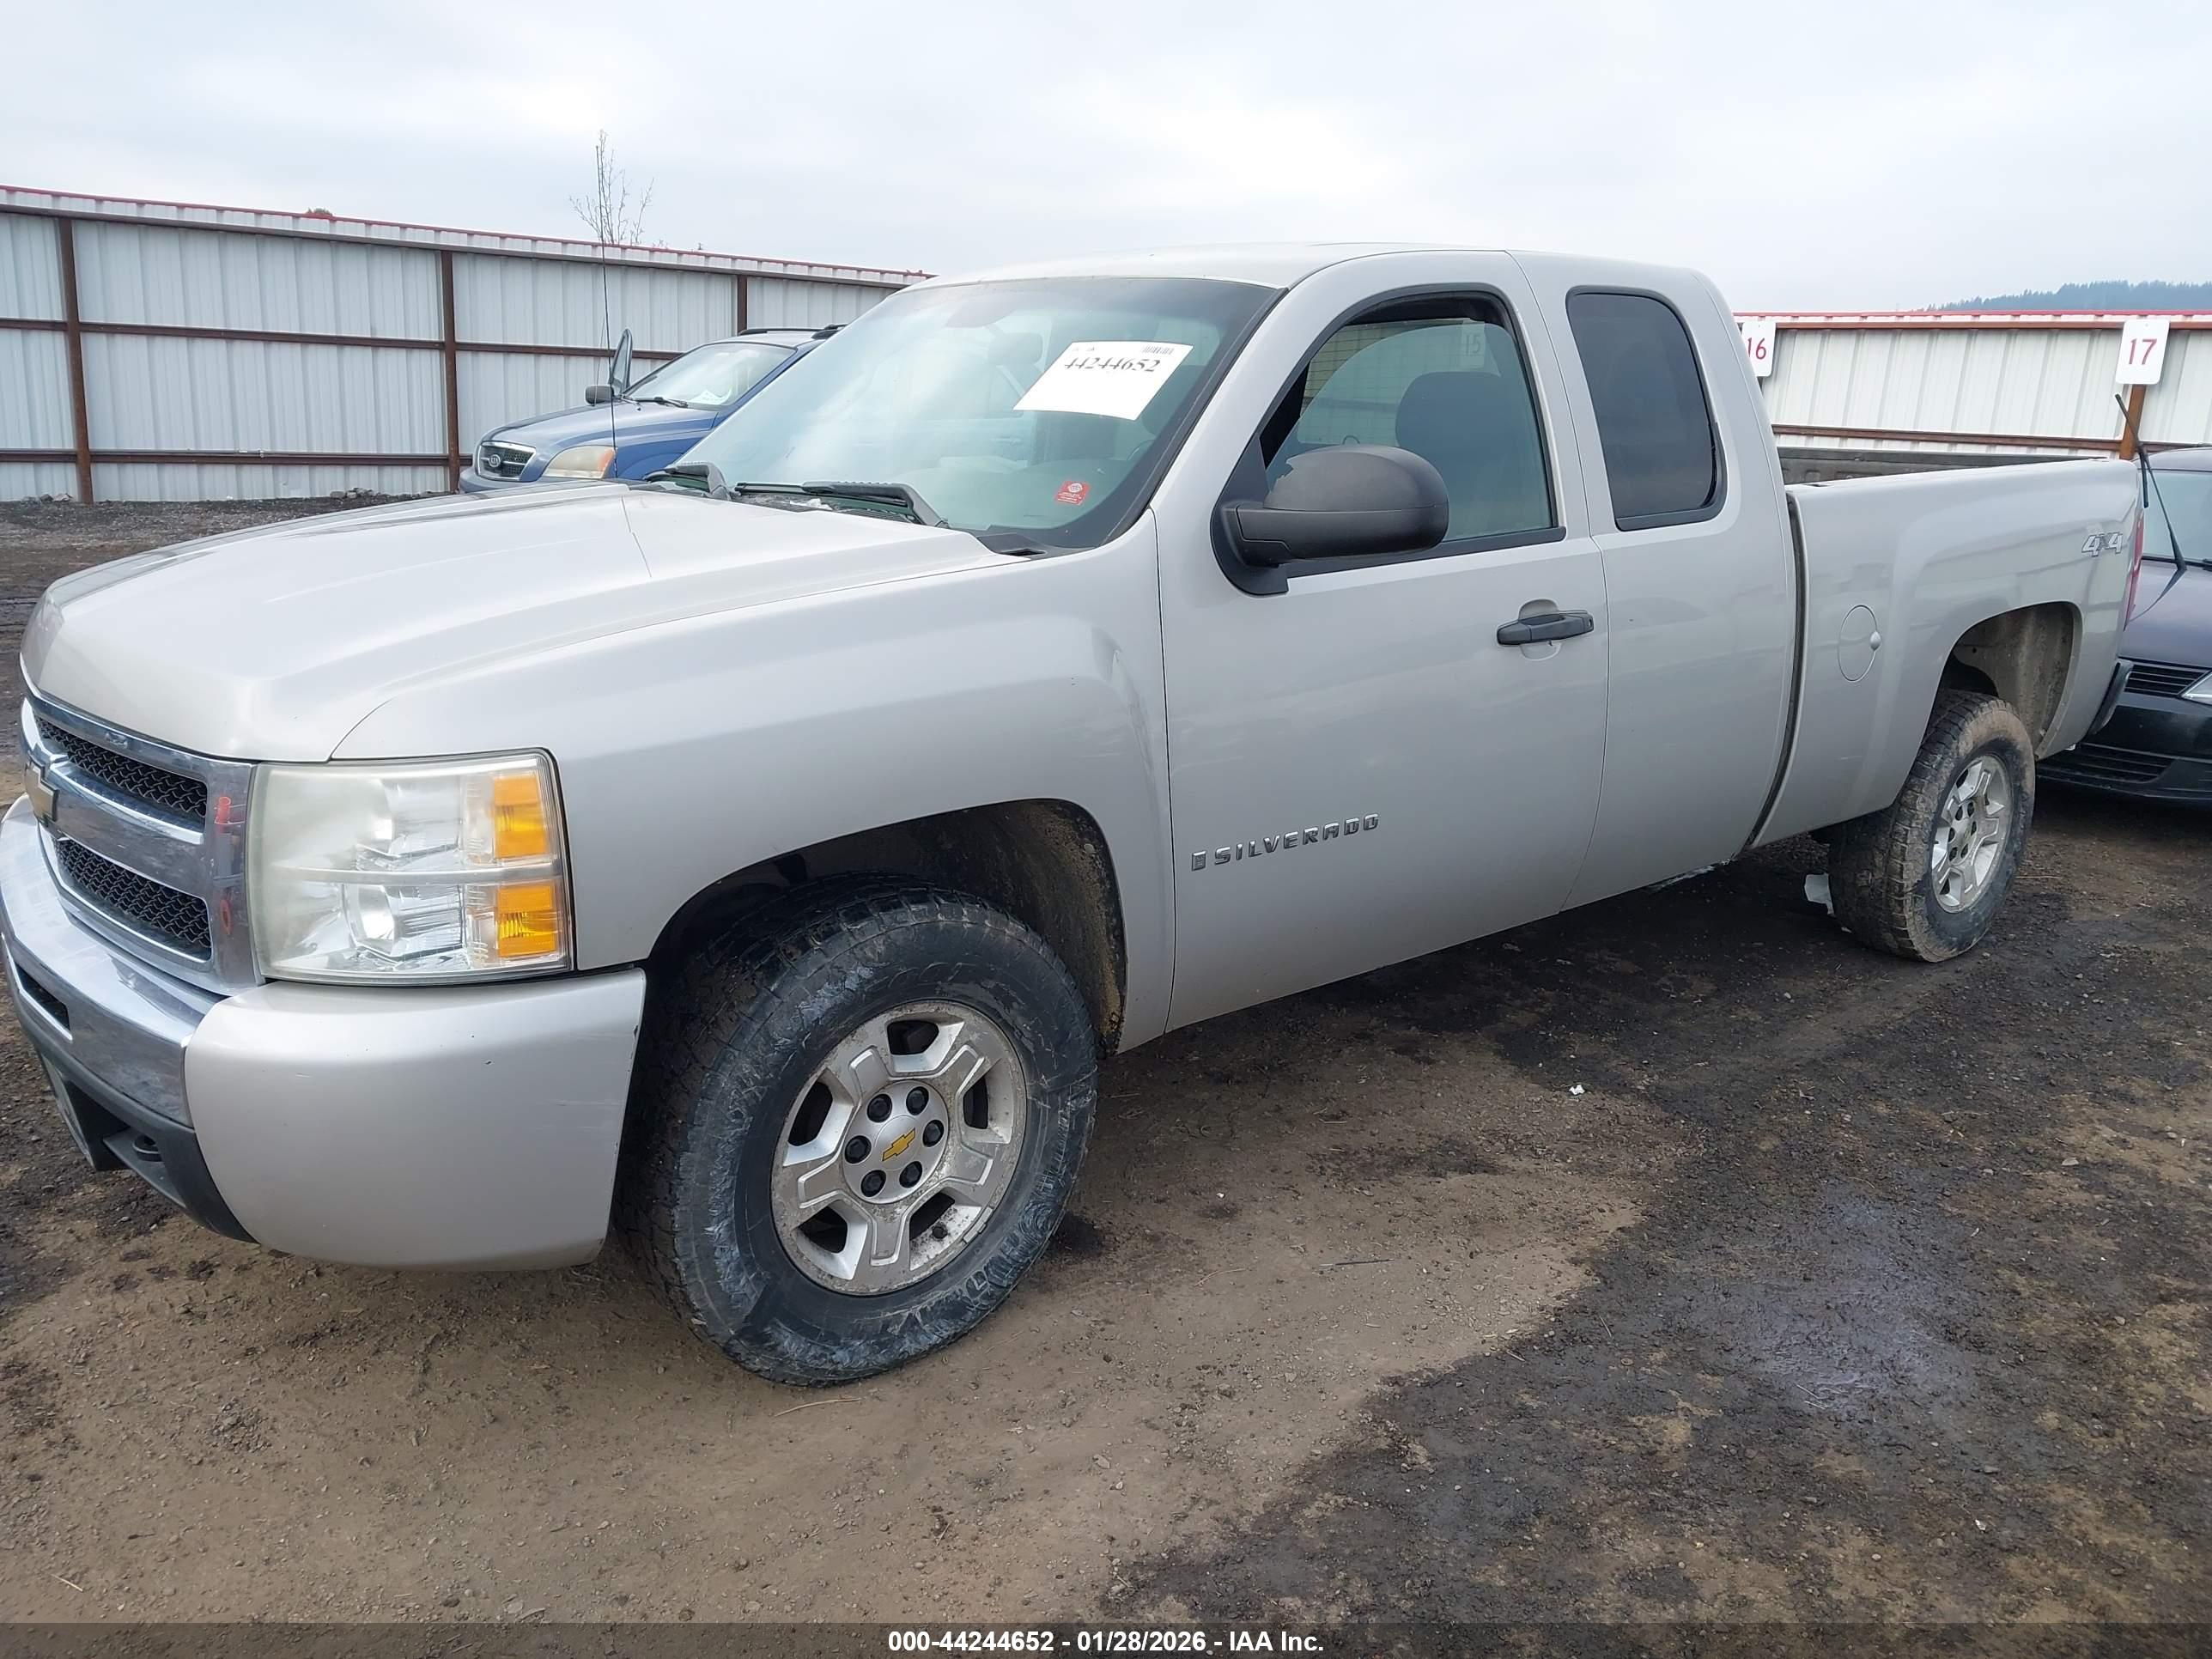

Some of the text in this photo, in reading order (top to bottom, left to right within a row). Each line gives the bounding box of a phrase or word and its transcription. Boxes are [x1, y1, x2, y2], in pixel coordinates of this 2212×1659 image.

[1747, 337, 1766, 360] 16
[2129, 338, 2157, 365] 17
[1064, 357, 1161, 372] 44244652
[1214, 812, 1379, 866] SILVERADO
